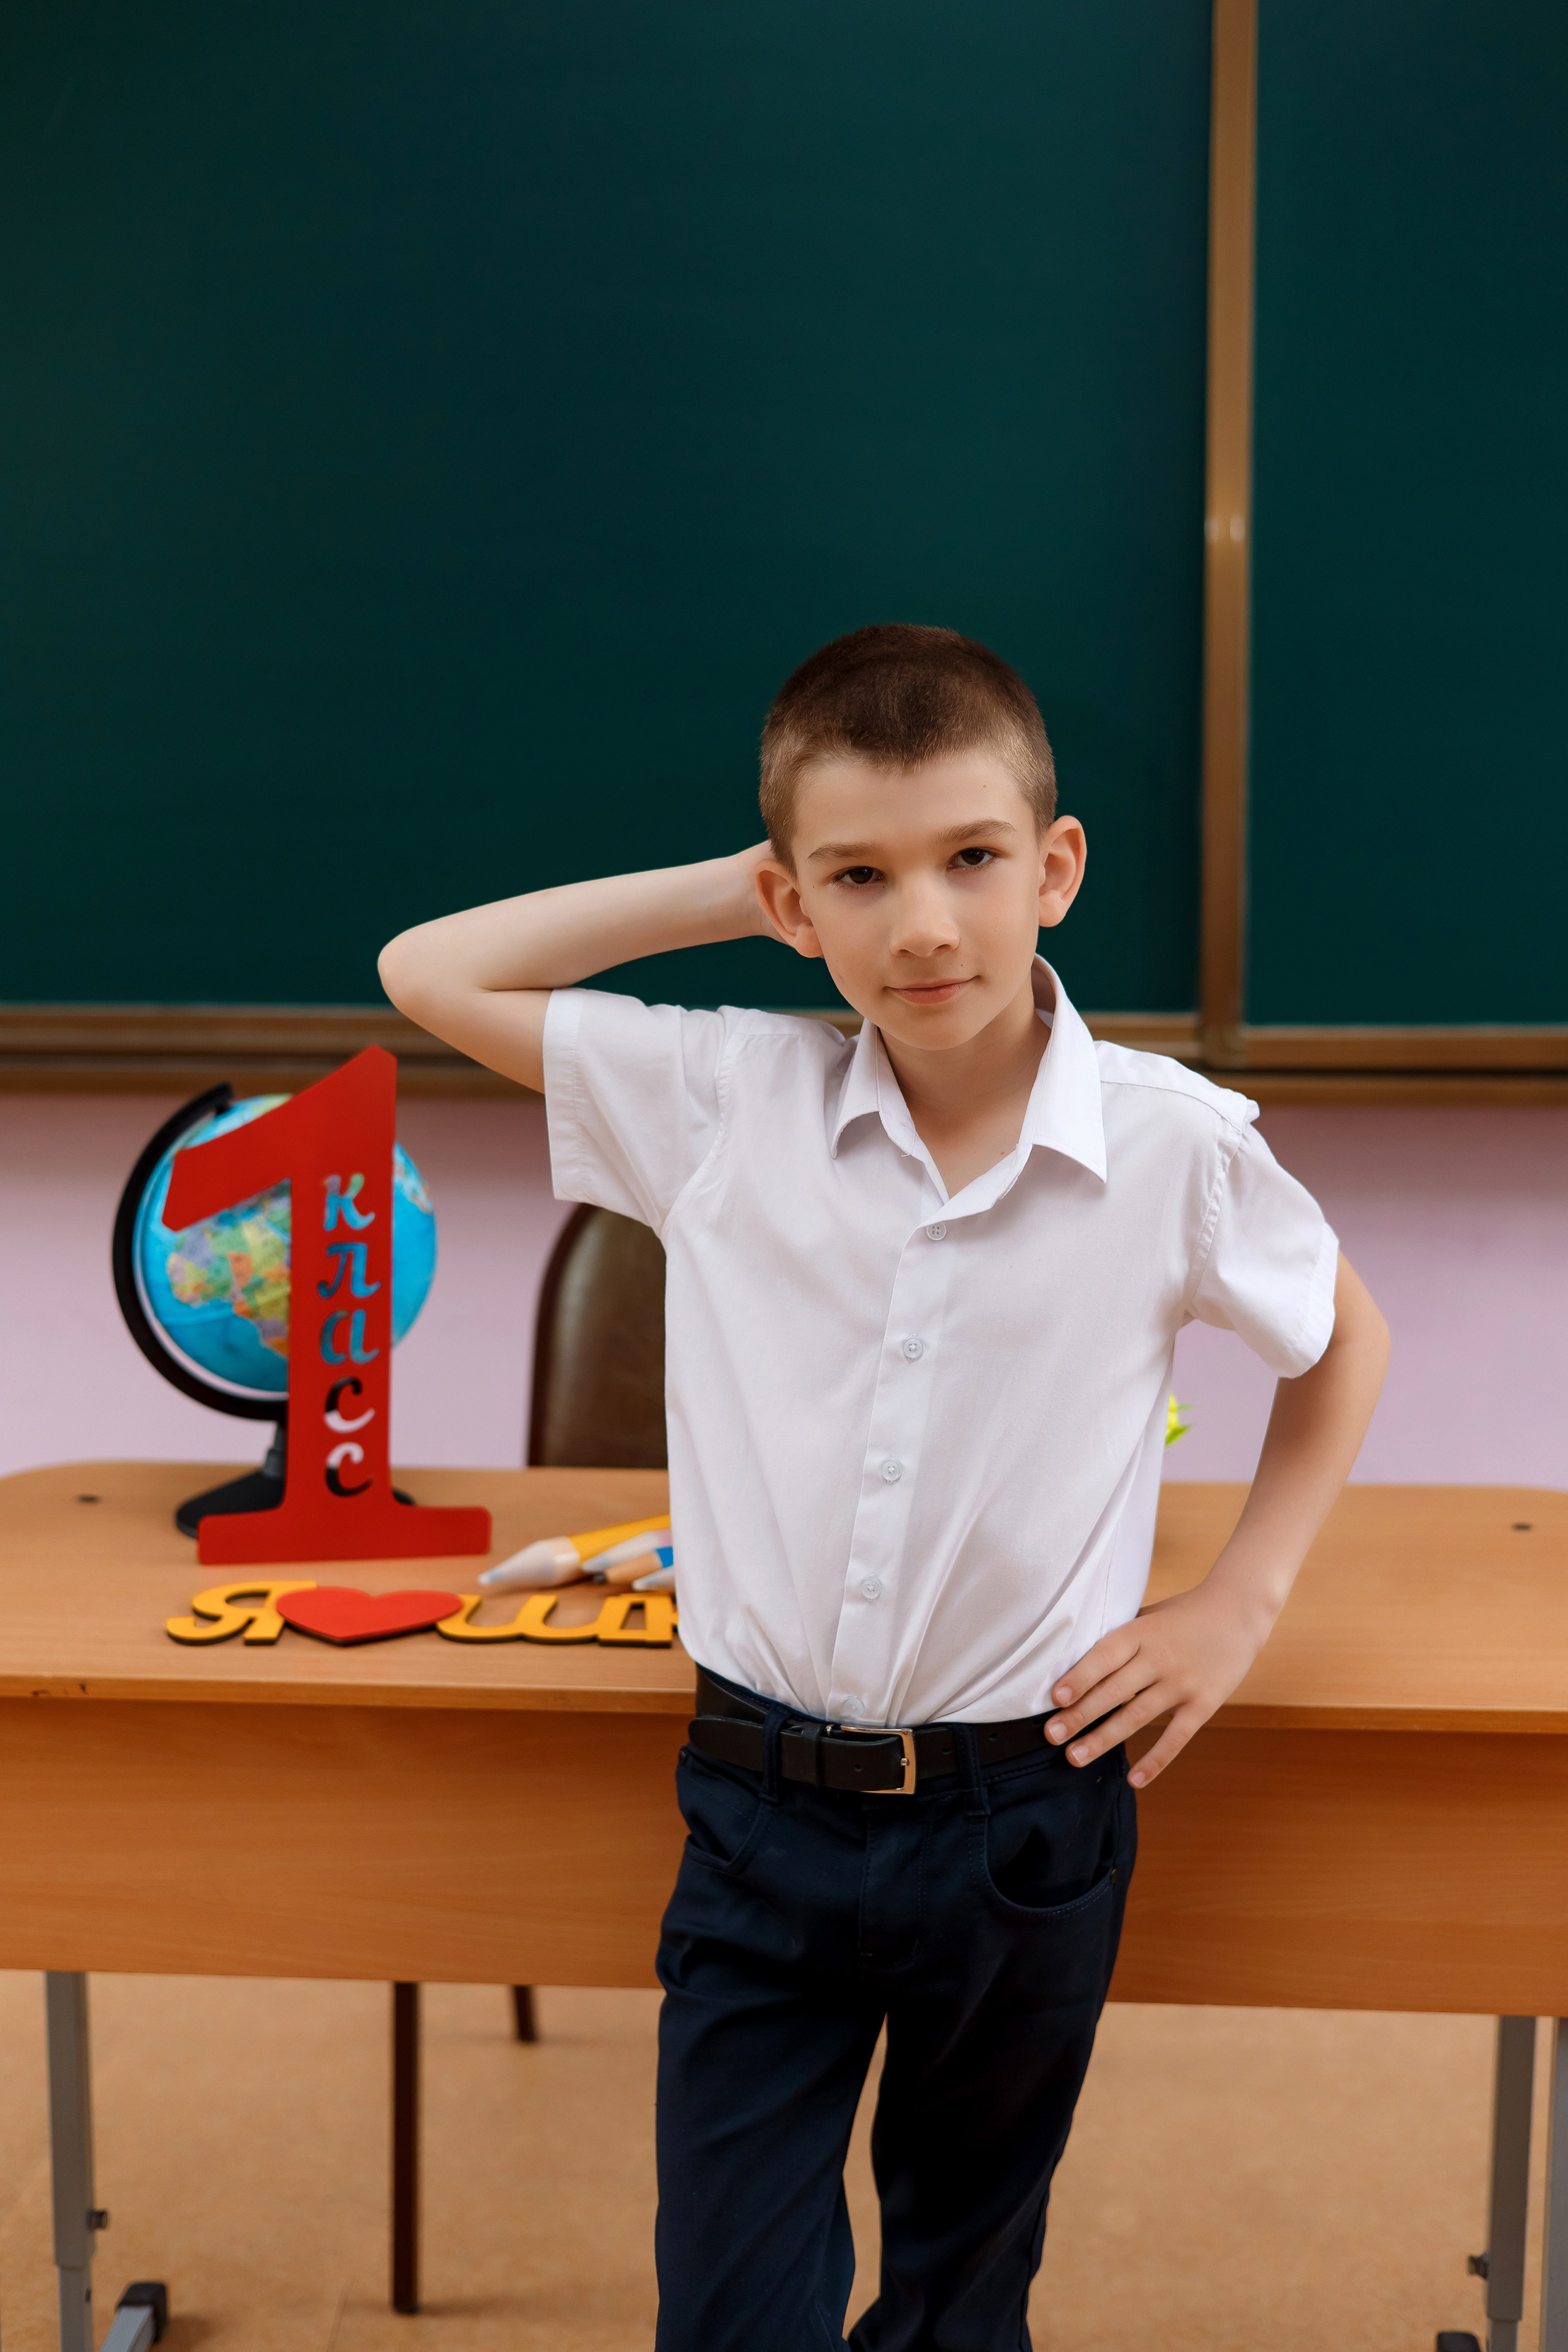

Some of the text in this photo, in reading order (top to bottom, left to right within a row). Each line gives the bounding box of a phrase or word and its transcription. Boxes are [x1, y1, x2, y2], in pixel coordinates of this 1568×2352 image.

[162, 1045, 491, 1565] 1 класс
[166, 1580, 318, 1646] Я
